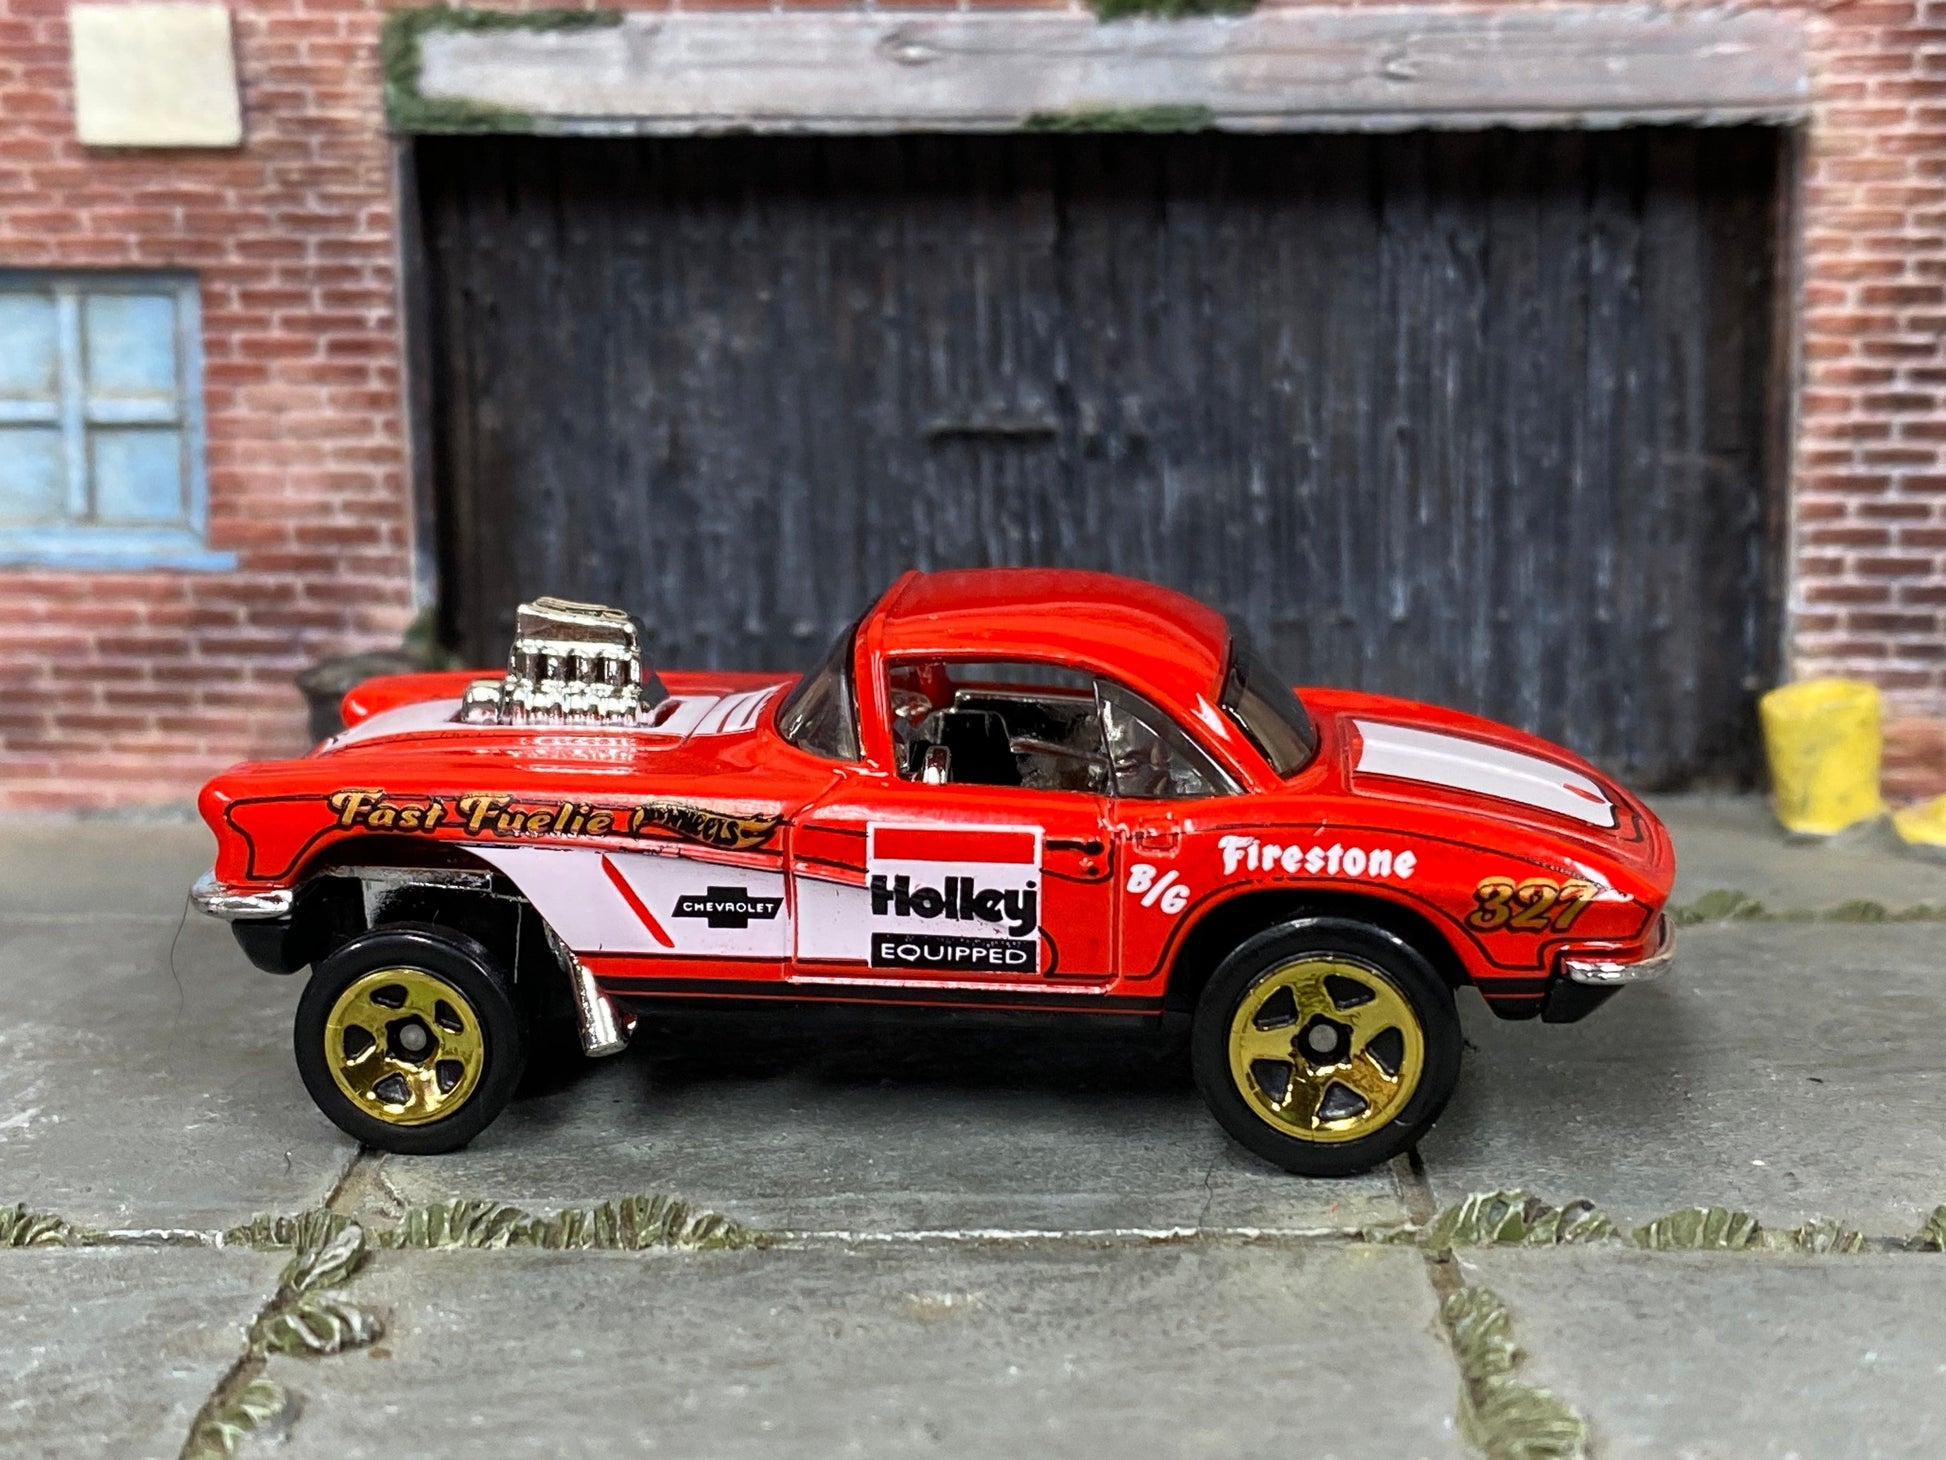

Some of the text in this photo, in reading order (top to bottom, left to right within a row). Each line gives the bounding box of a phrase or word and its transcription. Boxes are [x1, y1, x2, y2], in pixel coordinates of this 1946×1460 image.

[329, 788, 447, 833] Fast
[457, 791, 614, 836] Fuelie
[1218, 834, 1418, 880] Firestone
[682, 901, 775, 914] CHEVROLET
[871, 874, 1037, 938] Holley
[1465, 875, 1602, 934] 327
[880, 942, 1028, 965] EQUIPPED
